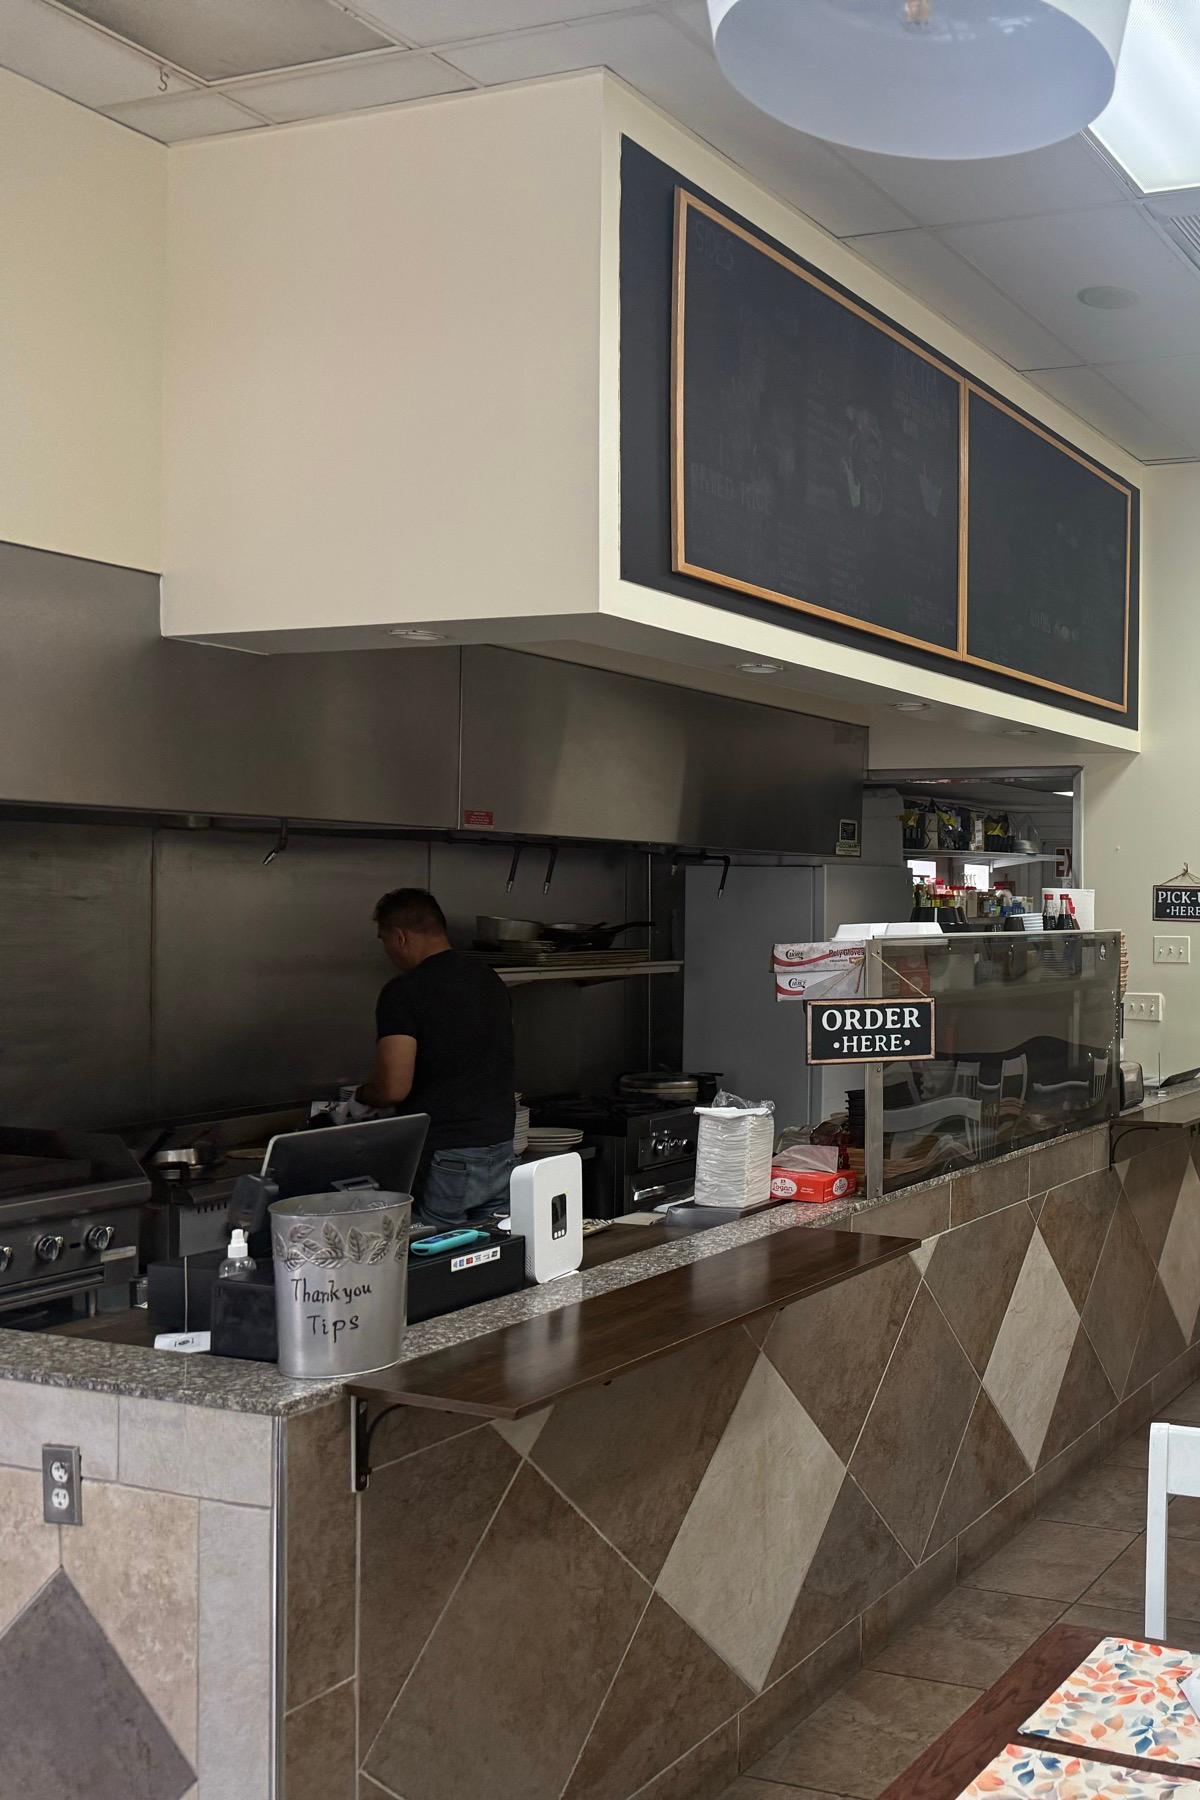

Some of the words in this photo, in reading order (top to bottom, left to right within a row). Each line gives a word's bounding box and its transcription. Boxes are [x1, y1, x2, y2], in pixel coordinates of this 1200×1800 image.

[821, 1007, 922, 1032] ORDER
[842, 1034, 903, 1053] HERE
[291, 1278, 340, 1304] Thank
[343, 1284, 373, 1304] you
[306, 1314, 360, 1344] Tips
